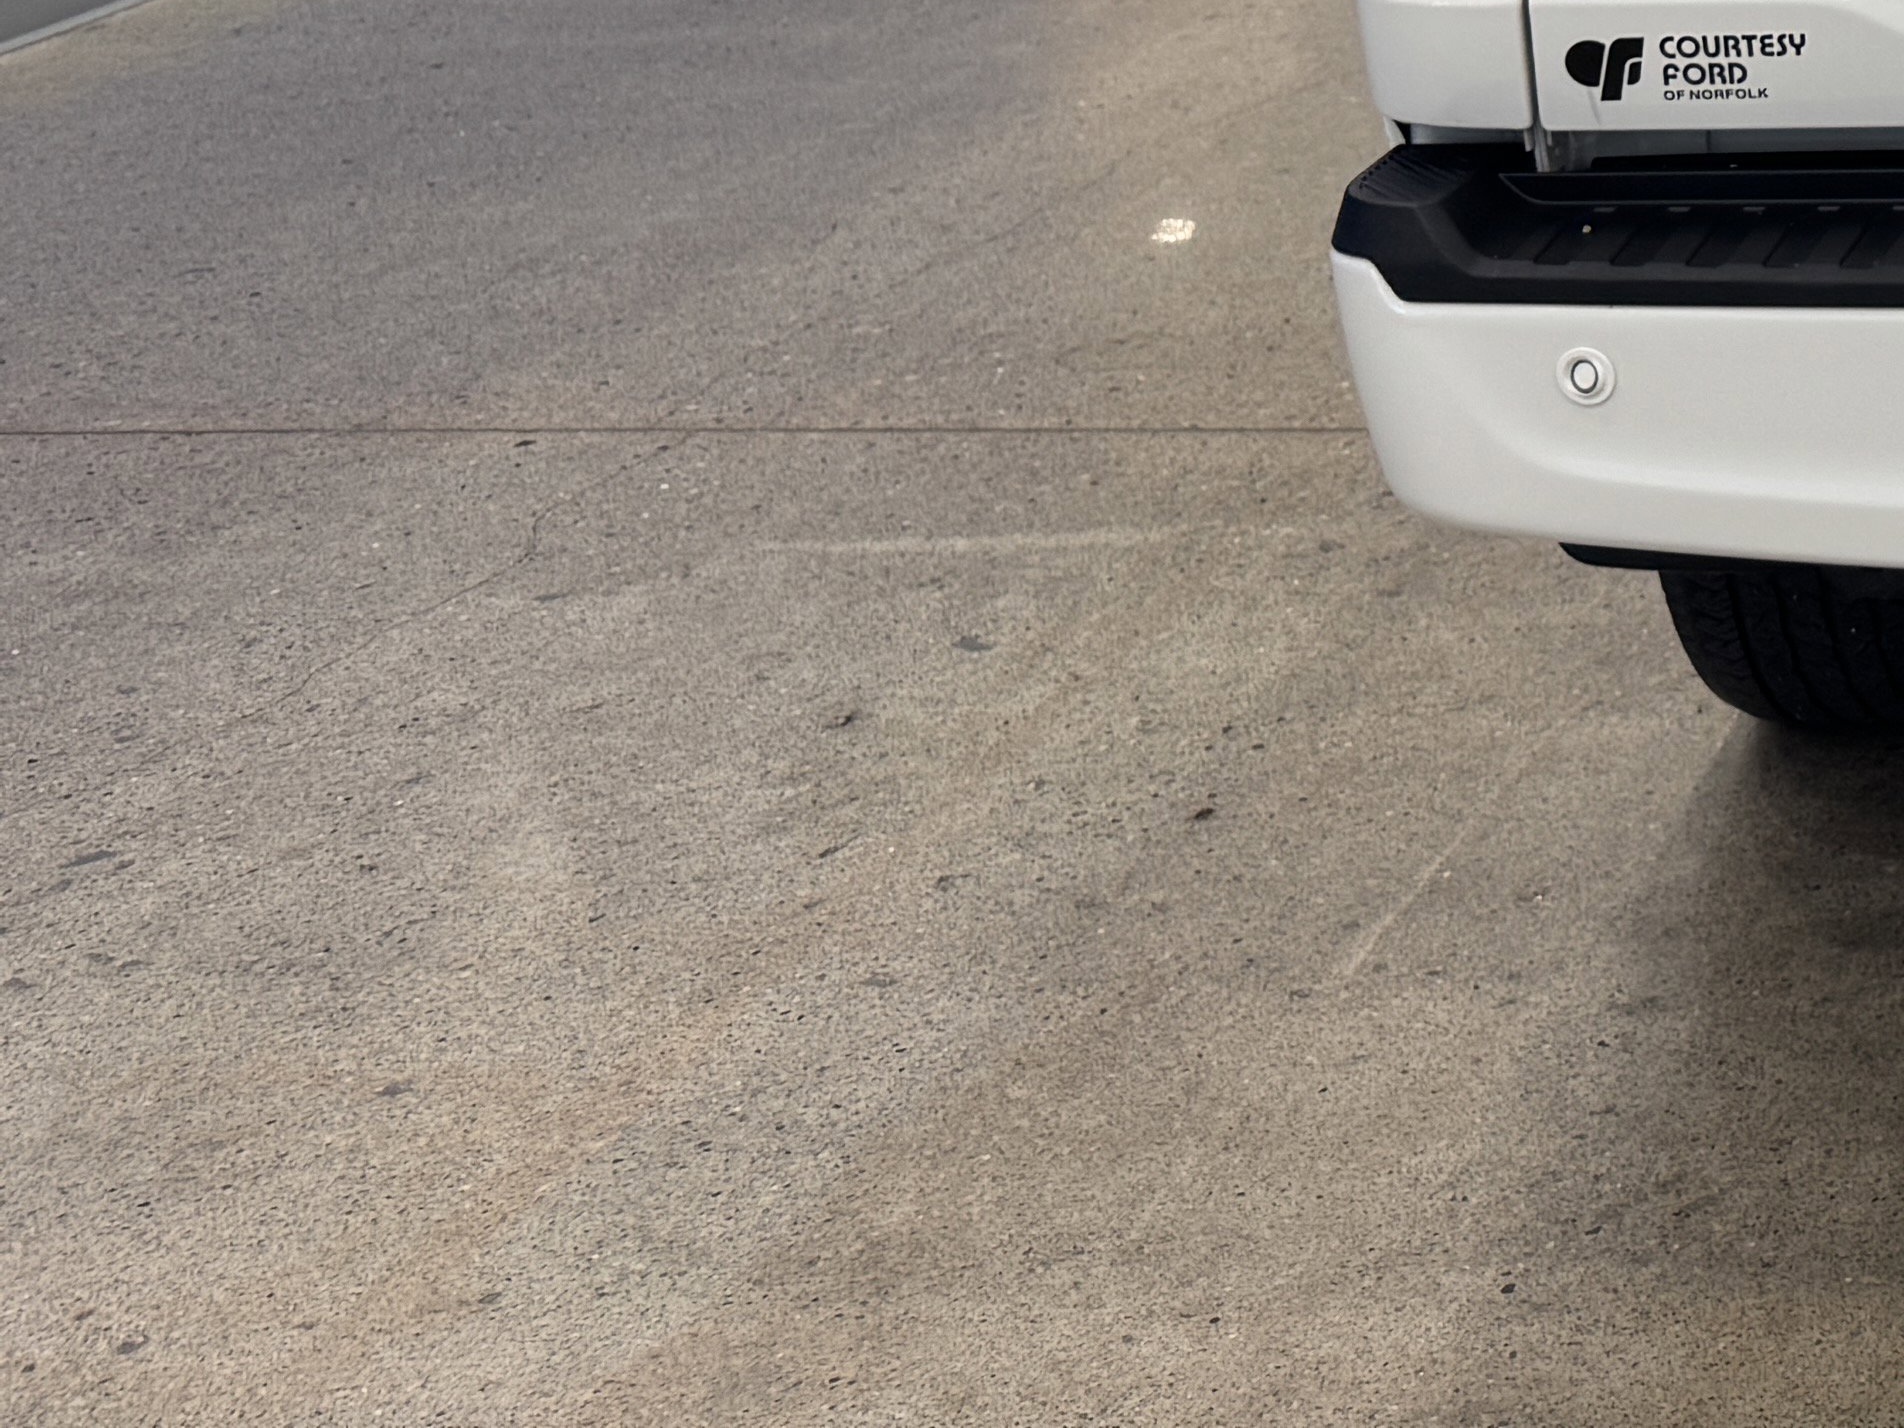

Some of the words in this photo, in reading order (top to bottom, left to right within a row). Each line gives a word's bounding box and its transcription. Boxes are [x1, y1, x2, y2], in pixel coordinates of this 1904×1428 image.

[1659, 33, 1807, 59] COURTESY
[1662, 61, 1748, 86] FORD
[1663, 89, 1685, 101] OF
[1689, 87, 1769, 100] NORFOLK
